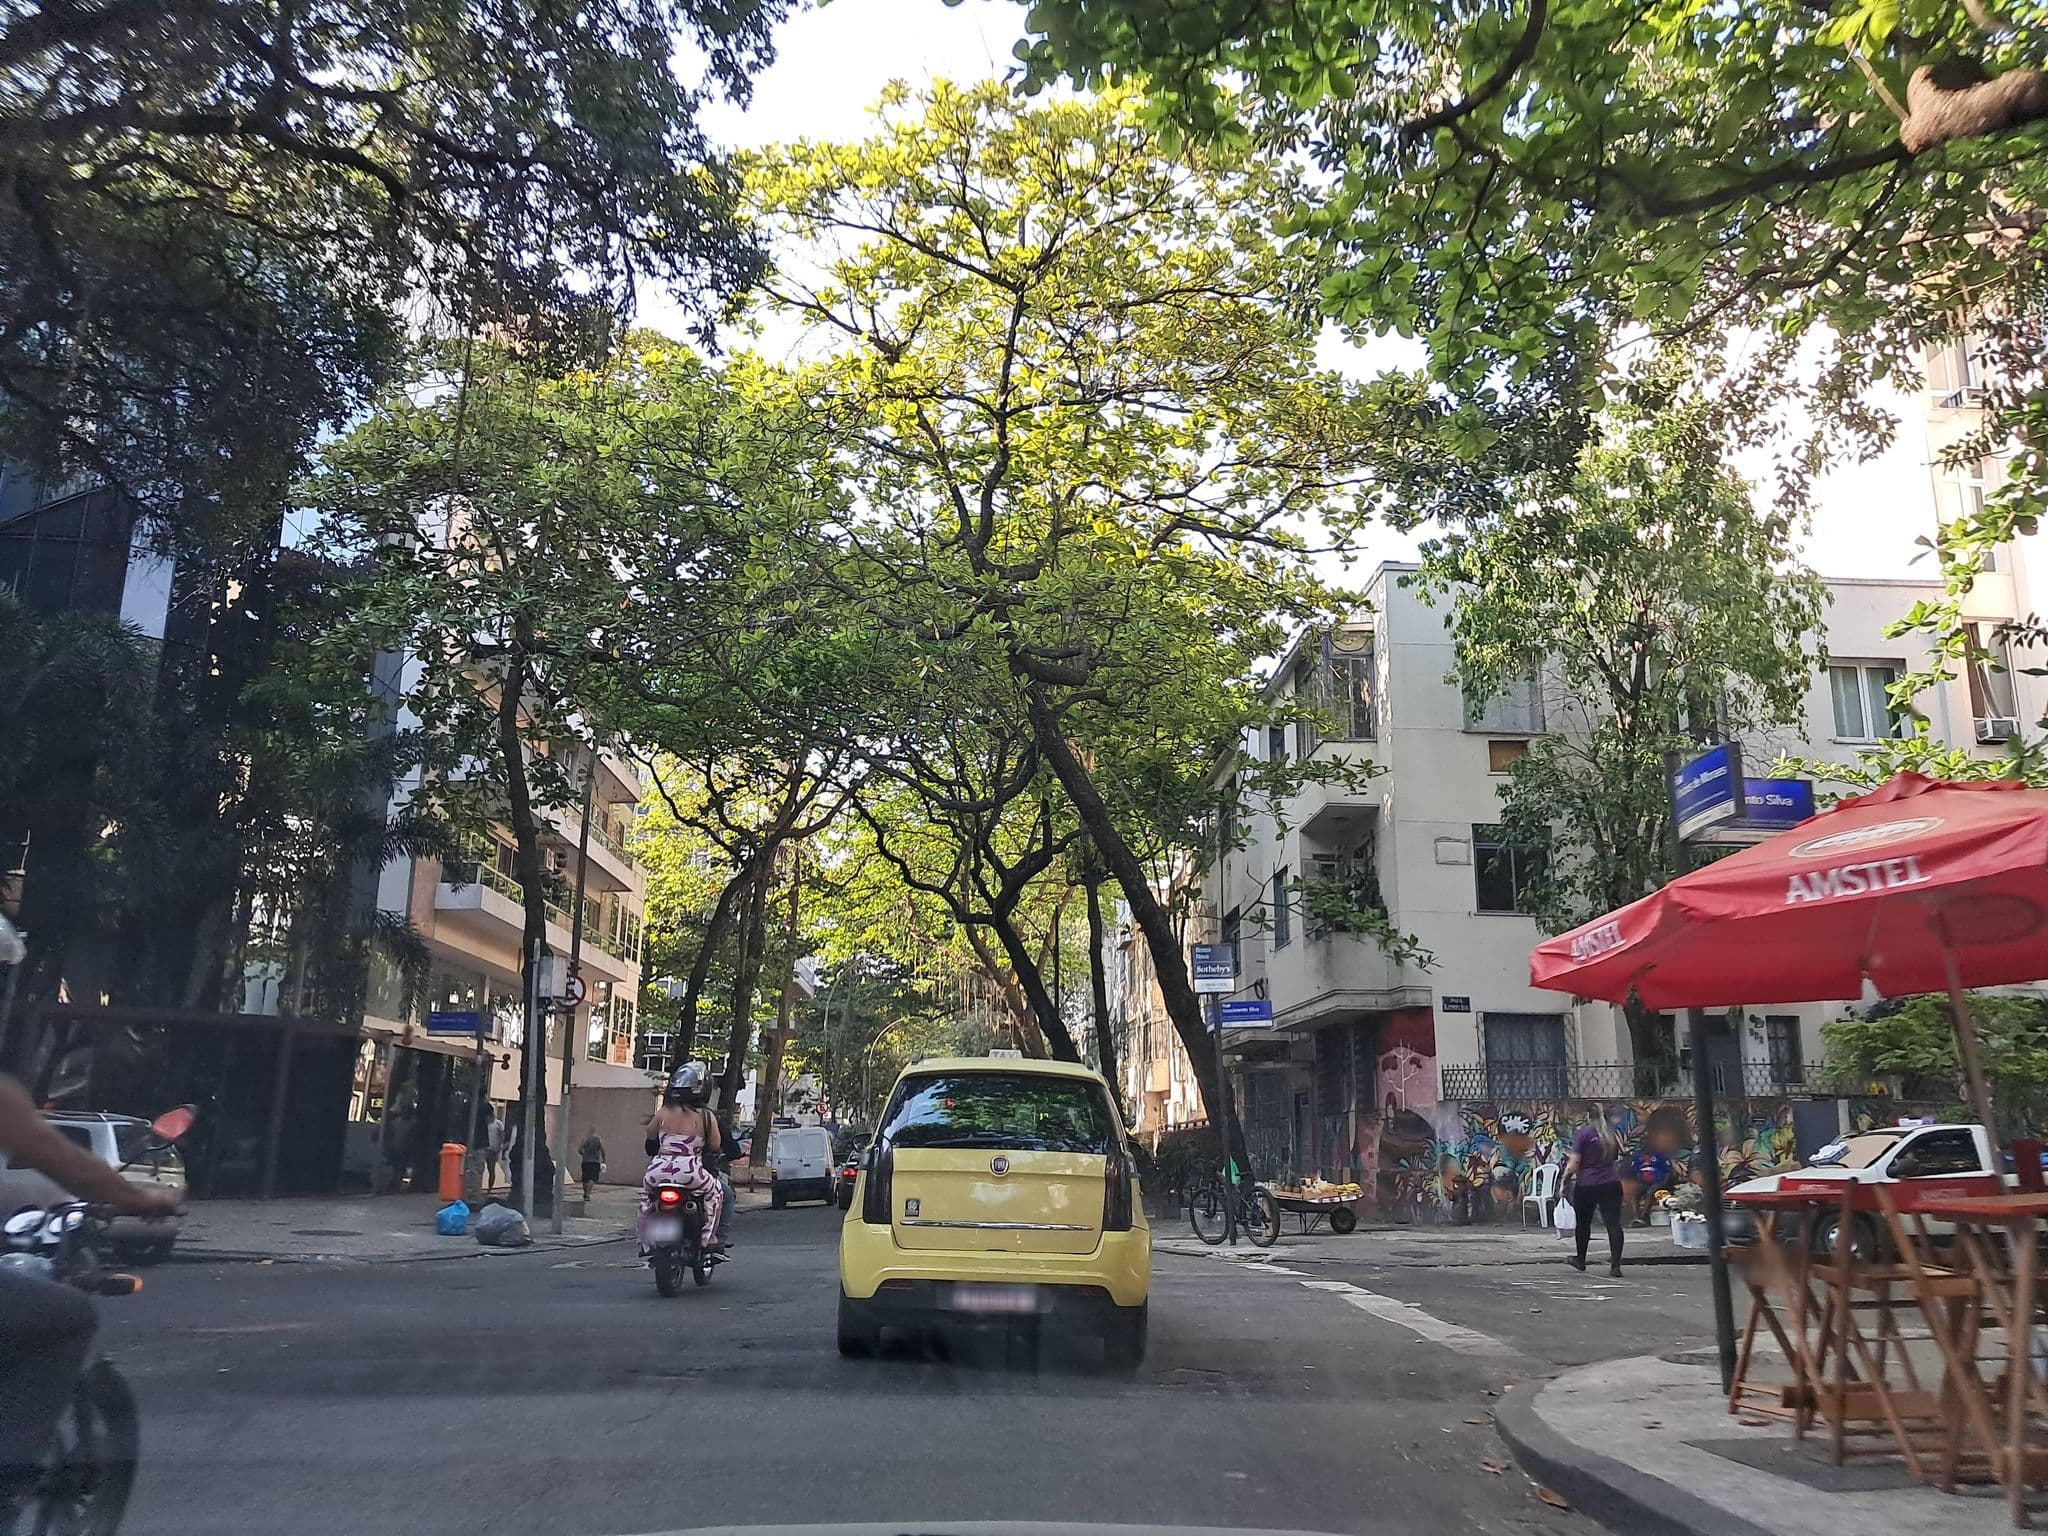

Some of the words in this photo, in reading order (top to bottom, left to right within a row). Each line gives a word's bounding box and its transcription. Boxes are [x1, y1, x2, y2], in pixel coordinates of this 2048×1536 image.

[1766, 794, 1793, 807] Silva
[1785, 855, 1932, 905] AMSTEL
[1570, 920, 1627, 961] AMSTEL
[1196, 964, 1230, 975] Sotheby's
